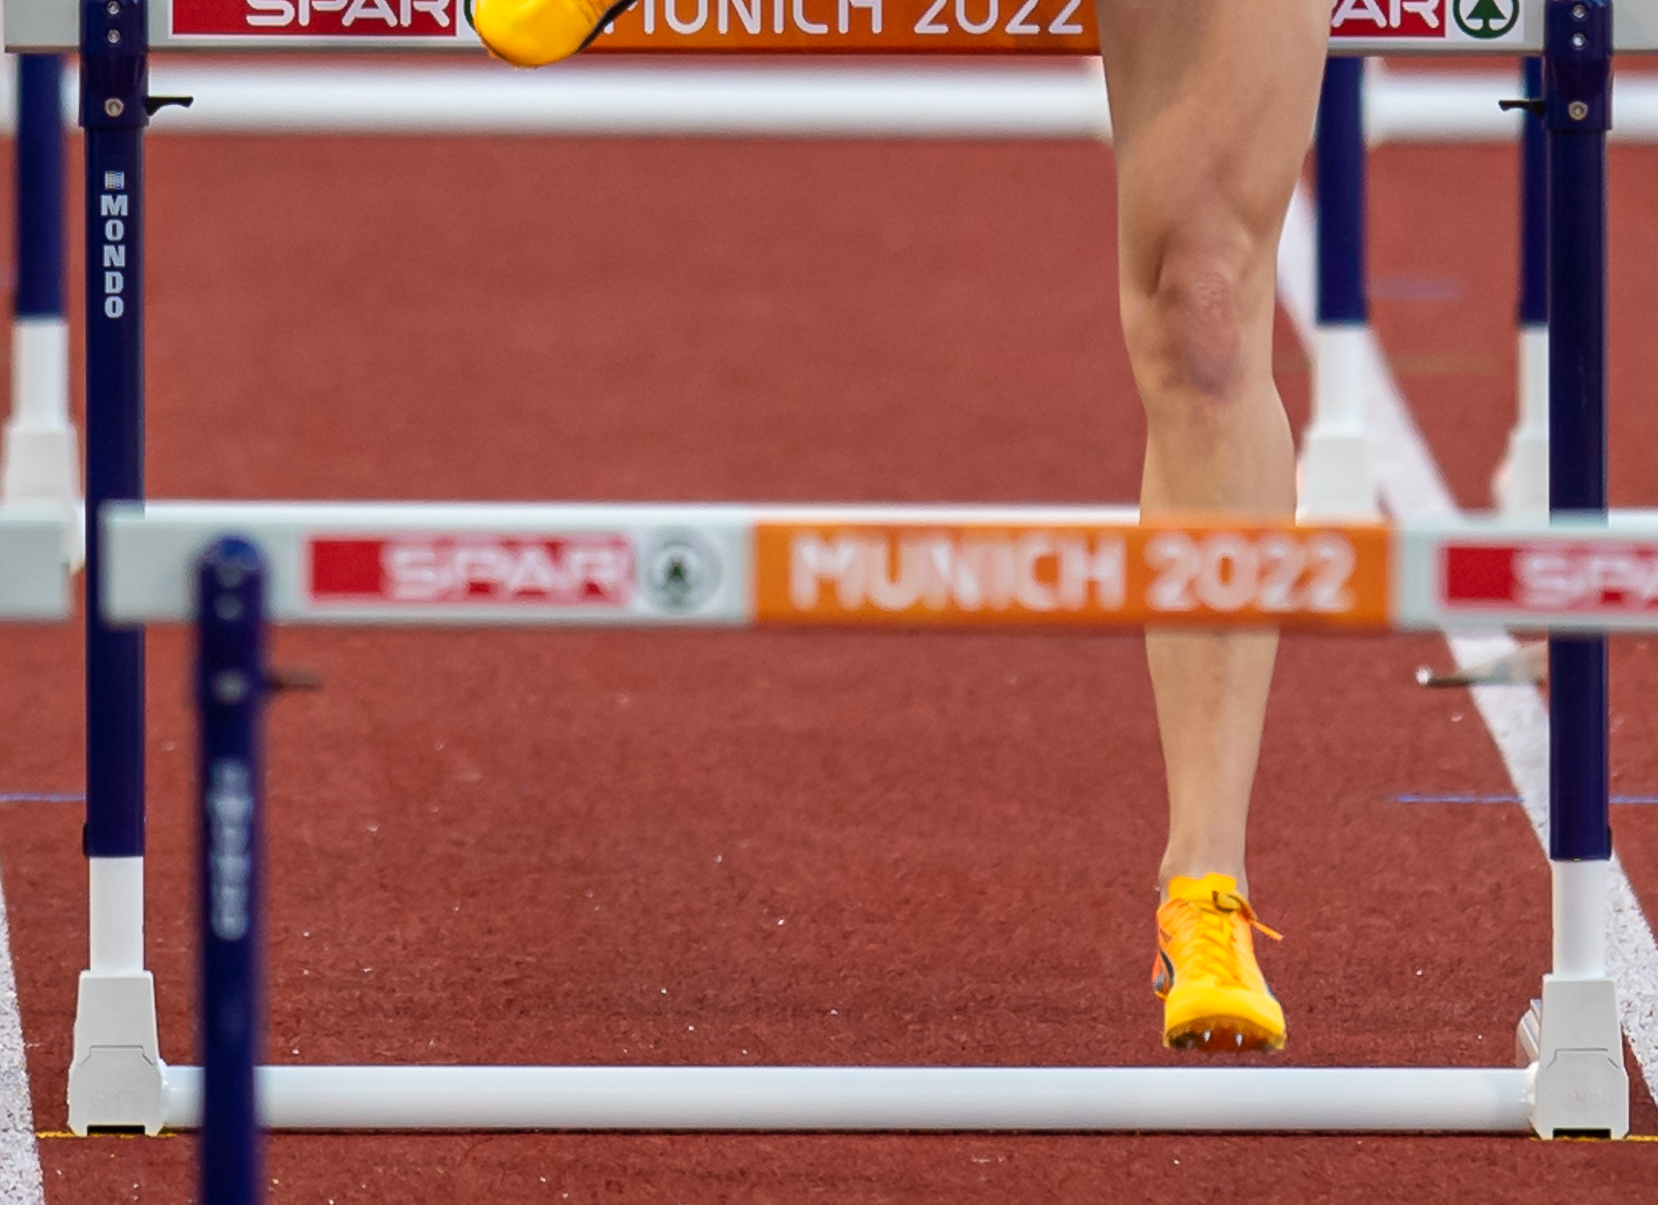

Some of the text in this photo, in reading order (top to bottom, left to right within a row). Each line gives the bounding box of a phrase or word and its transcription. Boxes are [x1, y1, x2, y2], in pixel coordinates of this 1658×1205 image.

[101, 194, 128, 318] MONDO
[387, 546, 630, 602] SPAR
[789, 530, 1358, 614] MUNICH 2022
